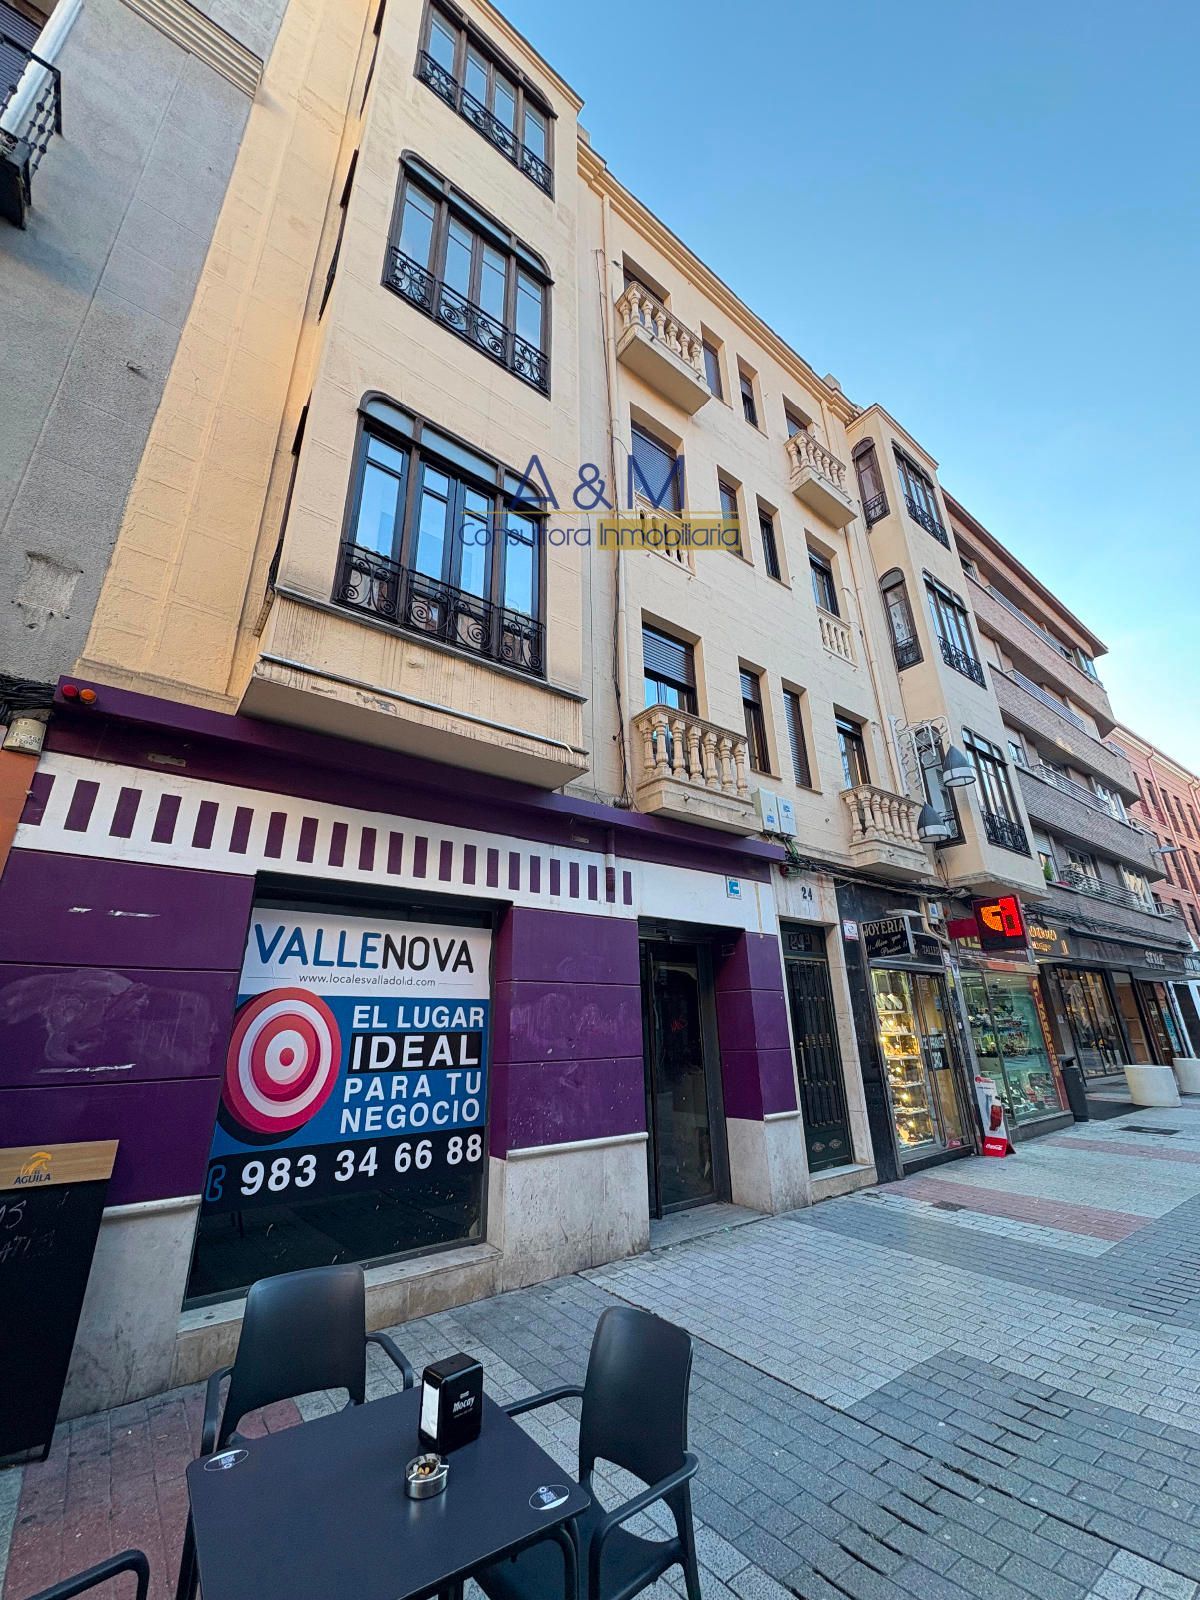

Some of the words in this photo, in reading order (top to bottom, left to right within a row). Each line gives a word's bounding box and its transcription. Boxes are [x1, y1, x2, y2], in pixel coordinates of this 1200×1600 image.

[801, 886, 813, 901] 24
[254, 923, 475, 974] VALLENOVA
[299, 973, 436, 987] www.localesvalladolid.com
[352, 1006, 388, 1029] EL
[397, 1006, 485, 1029] LUGAR
[352, 1034, 480, 1071] IDEAL
[343, 1073, 432, 1103] PARA
[447, 1071, 482, 1096] TU
[339, 1097, 481, 1135] NEGOCIO
[240, 1153, 318, 1196] 983
[334, 1146, 379, 1182] 34
[394, 1139, 433, 1174] 66
[446, 1133, 482, 1166] 88
